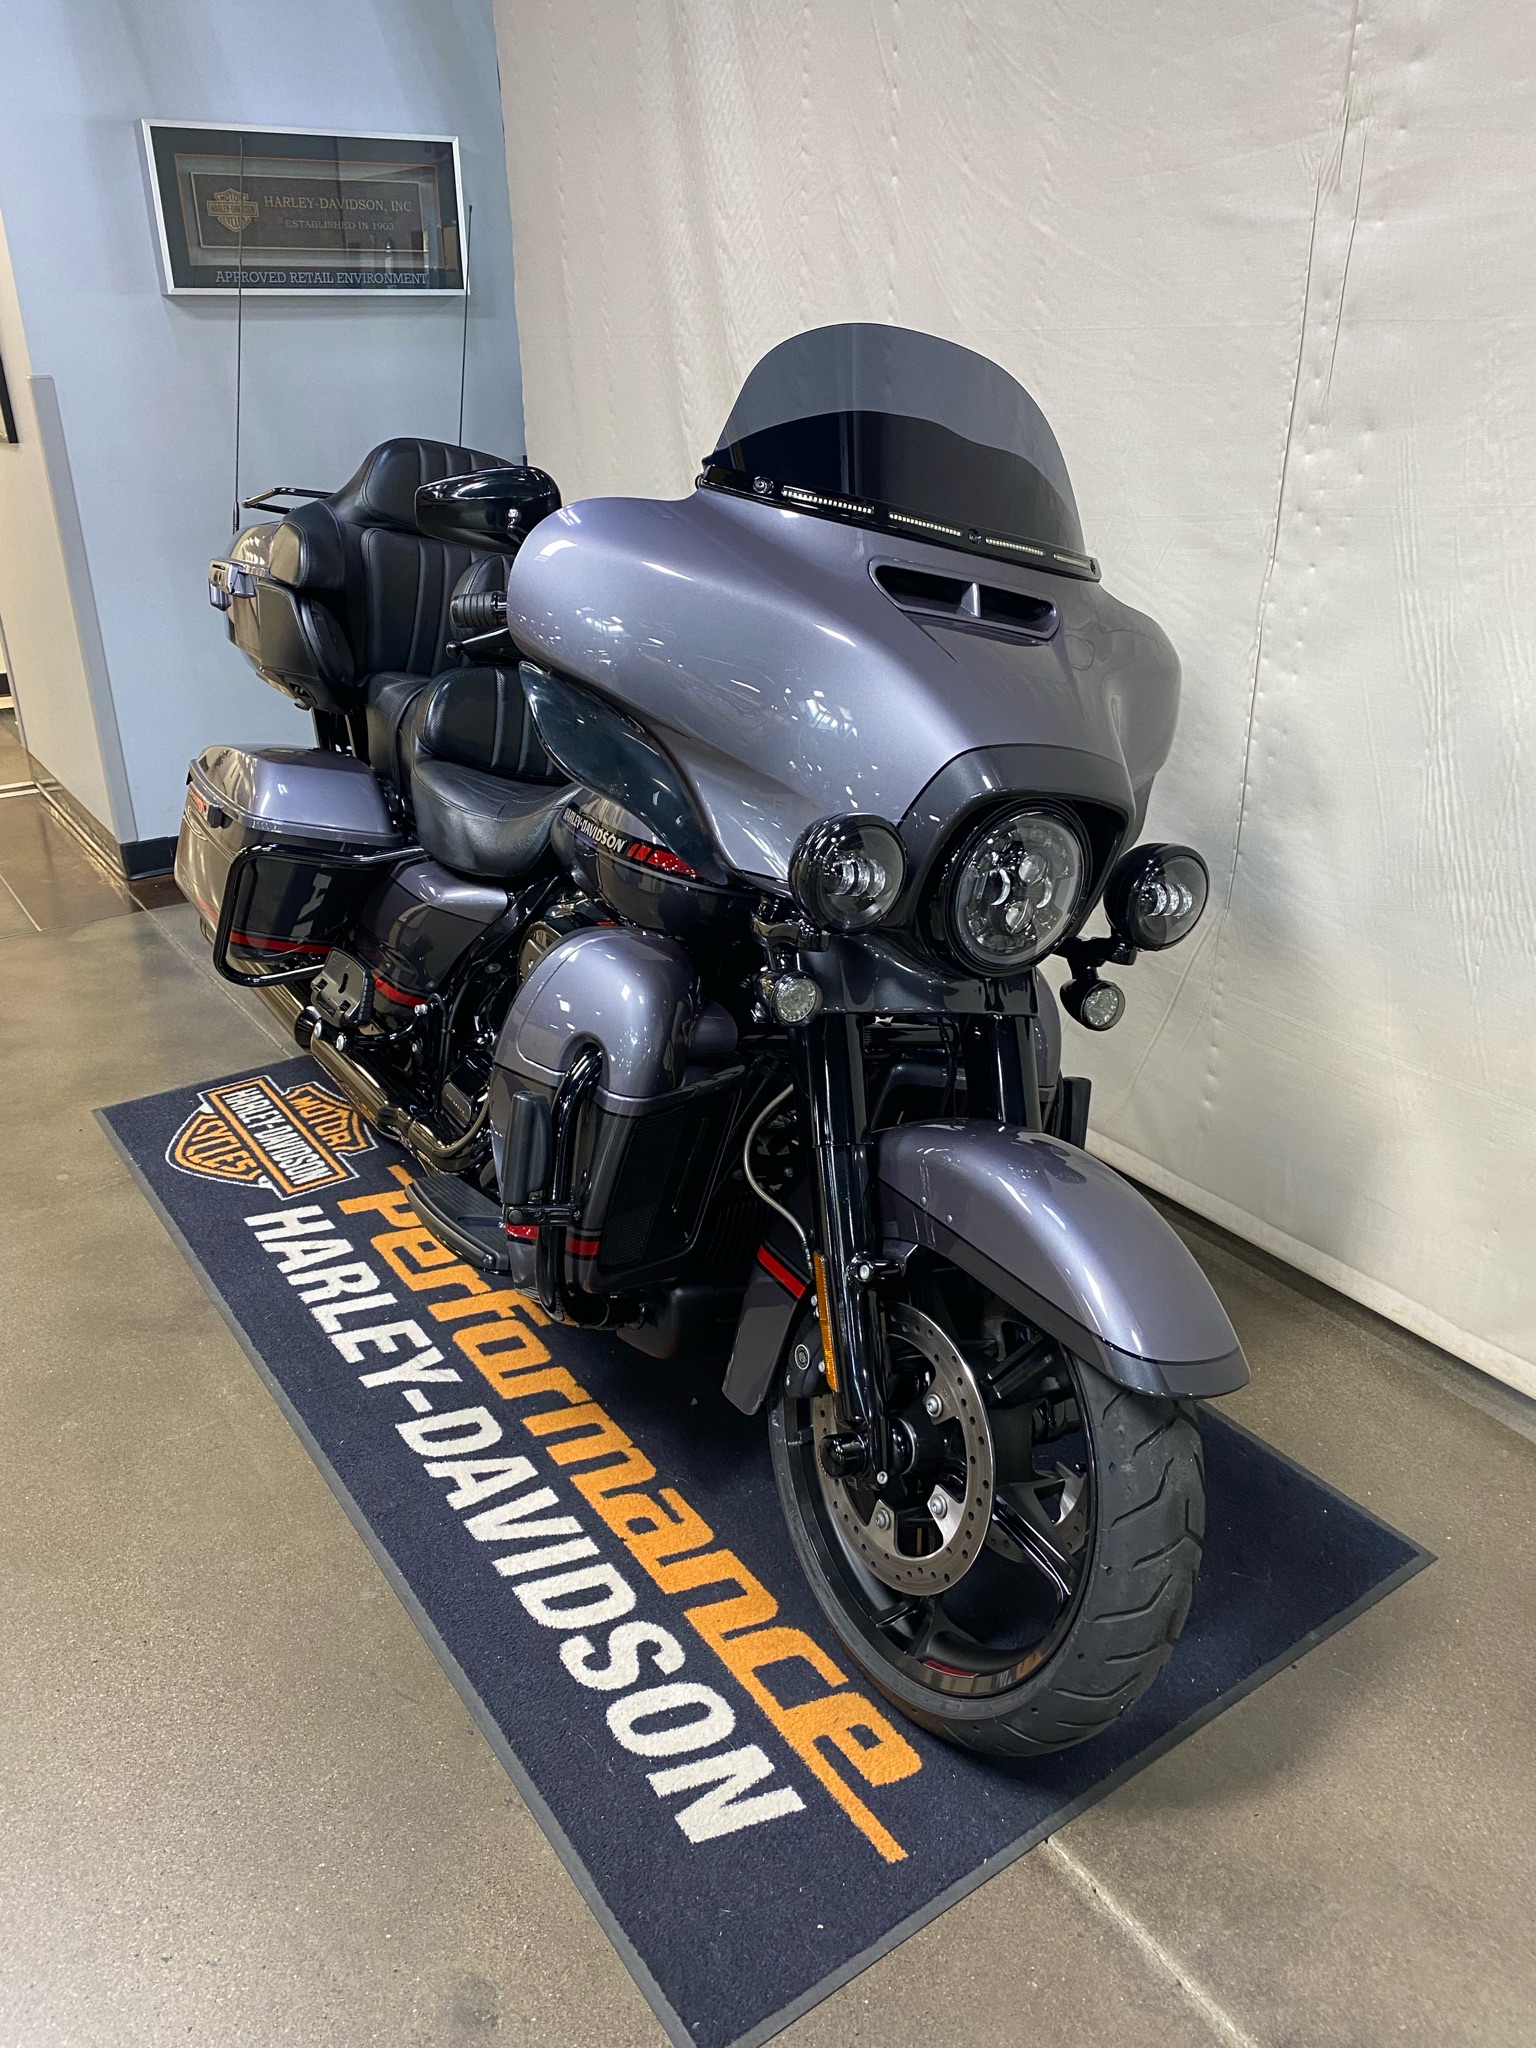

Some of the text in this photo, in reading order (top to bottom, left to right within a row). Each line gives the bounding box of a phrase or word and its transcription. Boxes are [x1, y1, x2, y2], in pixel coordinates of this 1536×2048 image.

[264, 195, 388, 213] HARLEY-DAVIDSON,
[285, 219, 395, 231] ESTABLISHED IN 1903
[215, 270, 428, 285] APPROVED RETAIL ENVIRONMENT
[563, 807, 626, 852] HARLEY-DAVIDSON
[222, 1087, 334, 1185] HARLEY-DAVIDSON
[290, 1095, 352, 1147] MOTOR
[185, 1120, 257, 1173] CYCLES
[244, 1205, 807, 1845] HARLEY-DAVIDSON
